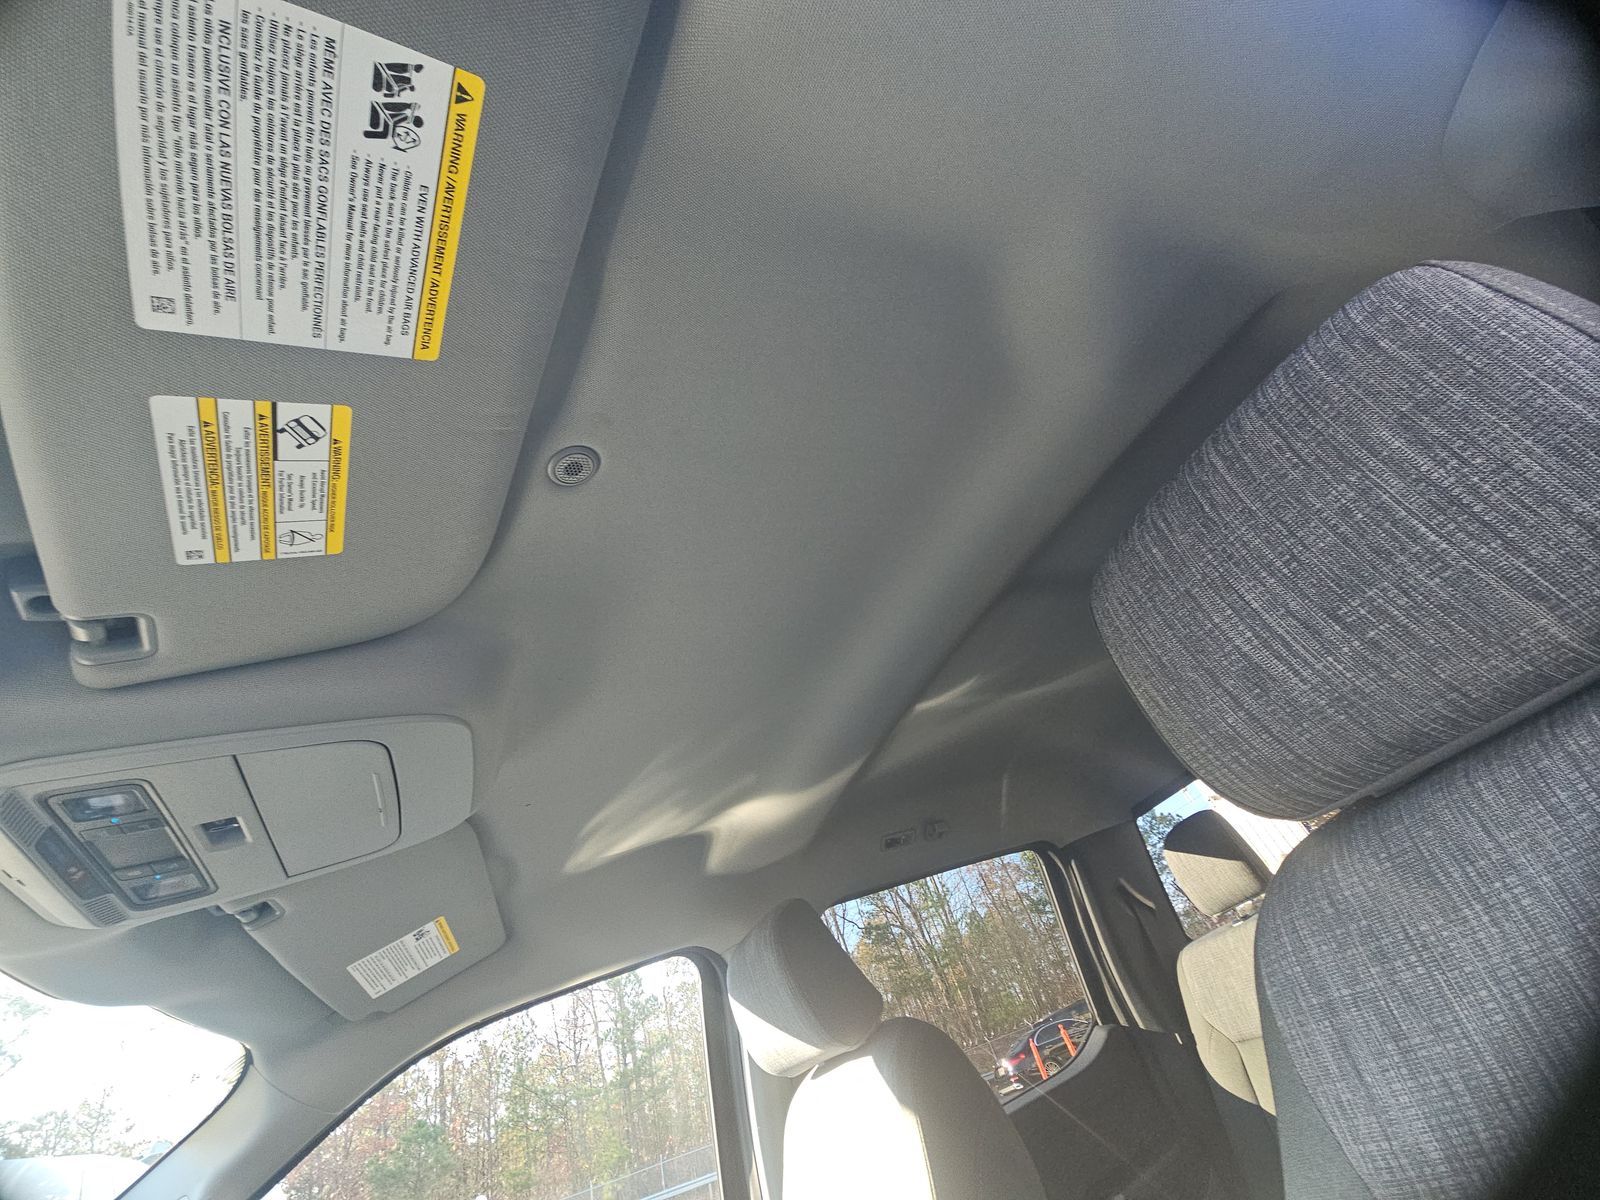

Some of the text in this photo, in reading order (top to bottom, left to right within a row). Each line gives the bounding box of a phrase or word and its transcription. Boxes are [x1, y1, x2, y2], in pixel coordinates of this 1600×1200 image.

[239, 26, 250, 101] sacs gonflables.
[138, 12, 158, 247] manual usuario información sobre bolsas
[188, 4, 203, 239] asiento trasero lugar seguro para niños.
[290, 42, 305, 260] siège arrière place plus sûre pour enfants.
[448, 113, 467, 174] WARNING
[155, 59, 176, 272] cinturón seguridad sujetadores para niños.
[171, 22, 194, 326] coloque asiento tipo mirando hacia asiento delantero.
[203, 17, 221, 289] niños pueden resultar fatal seriamente afectados bolsas
[218, 19, 237, 301] INCLUSIVE CON LAS NUEVAS BOLSAS DE AIRE
[252, 14, 265, 300] Consultez Guide propriétaire pour renseignements concernant
[266, 19, 280, 335] Utilisez toujours ceintures sécurité dispositifs retenue pour enfant.
[278, 38, 292, 288] placez jamais l'avant siège d'enfant faisant face l'arrière.
[300, 52, 318, 312] enfants peuvent être tués gravement blessés gonflable.
[377, 162, 387, 184] Never
[313, 36, 338, 338] MÊME AVEC DES SACS GONFLABLES PERFECTIONNÉS
[349, 171, 359, 202] Owner's
[375, 185, 384, 199] put
[400, 202, 408, 216] can
[402, 170, 413, 201] Children
[347, 203, 356, 230] Manual
[354, 158, 374, 302] Always seat belts child restraints.
[370, 206, 381, 245] rear-facing
[377, 167, 400, 315] The back seat the safest place for children.
[397, 227, 406, 246] killed
[342, 262, 352, 298] information
[370, 246, 378, 262] child
[391, 255, 402, 284] seriously
[401, 184, 430, 335] EVEN WITH ADVANCED AIR BAGS
[341, 299, 349, 317] about
[366, 297, 374, 313] front.
[390, 284, 399, 306] injured
[338, 327, 348, 343] bags.
[205, 429, 220, 488] ADVERTENCIA:
[259, 422, 271, 489] AVERTISSEMENT:
[332, 446, 342, 481] WARNING:
